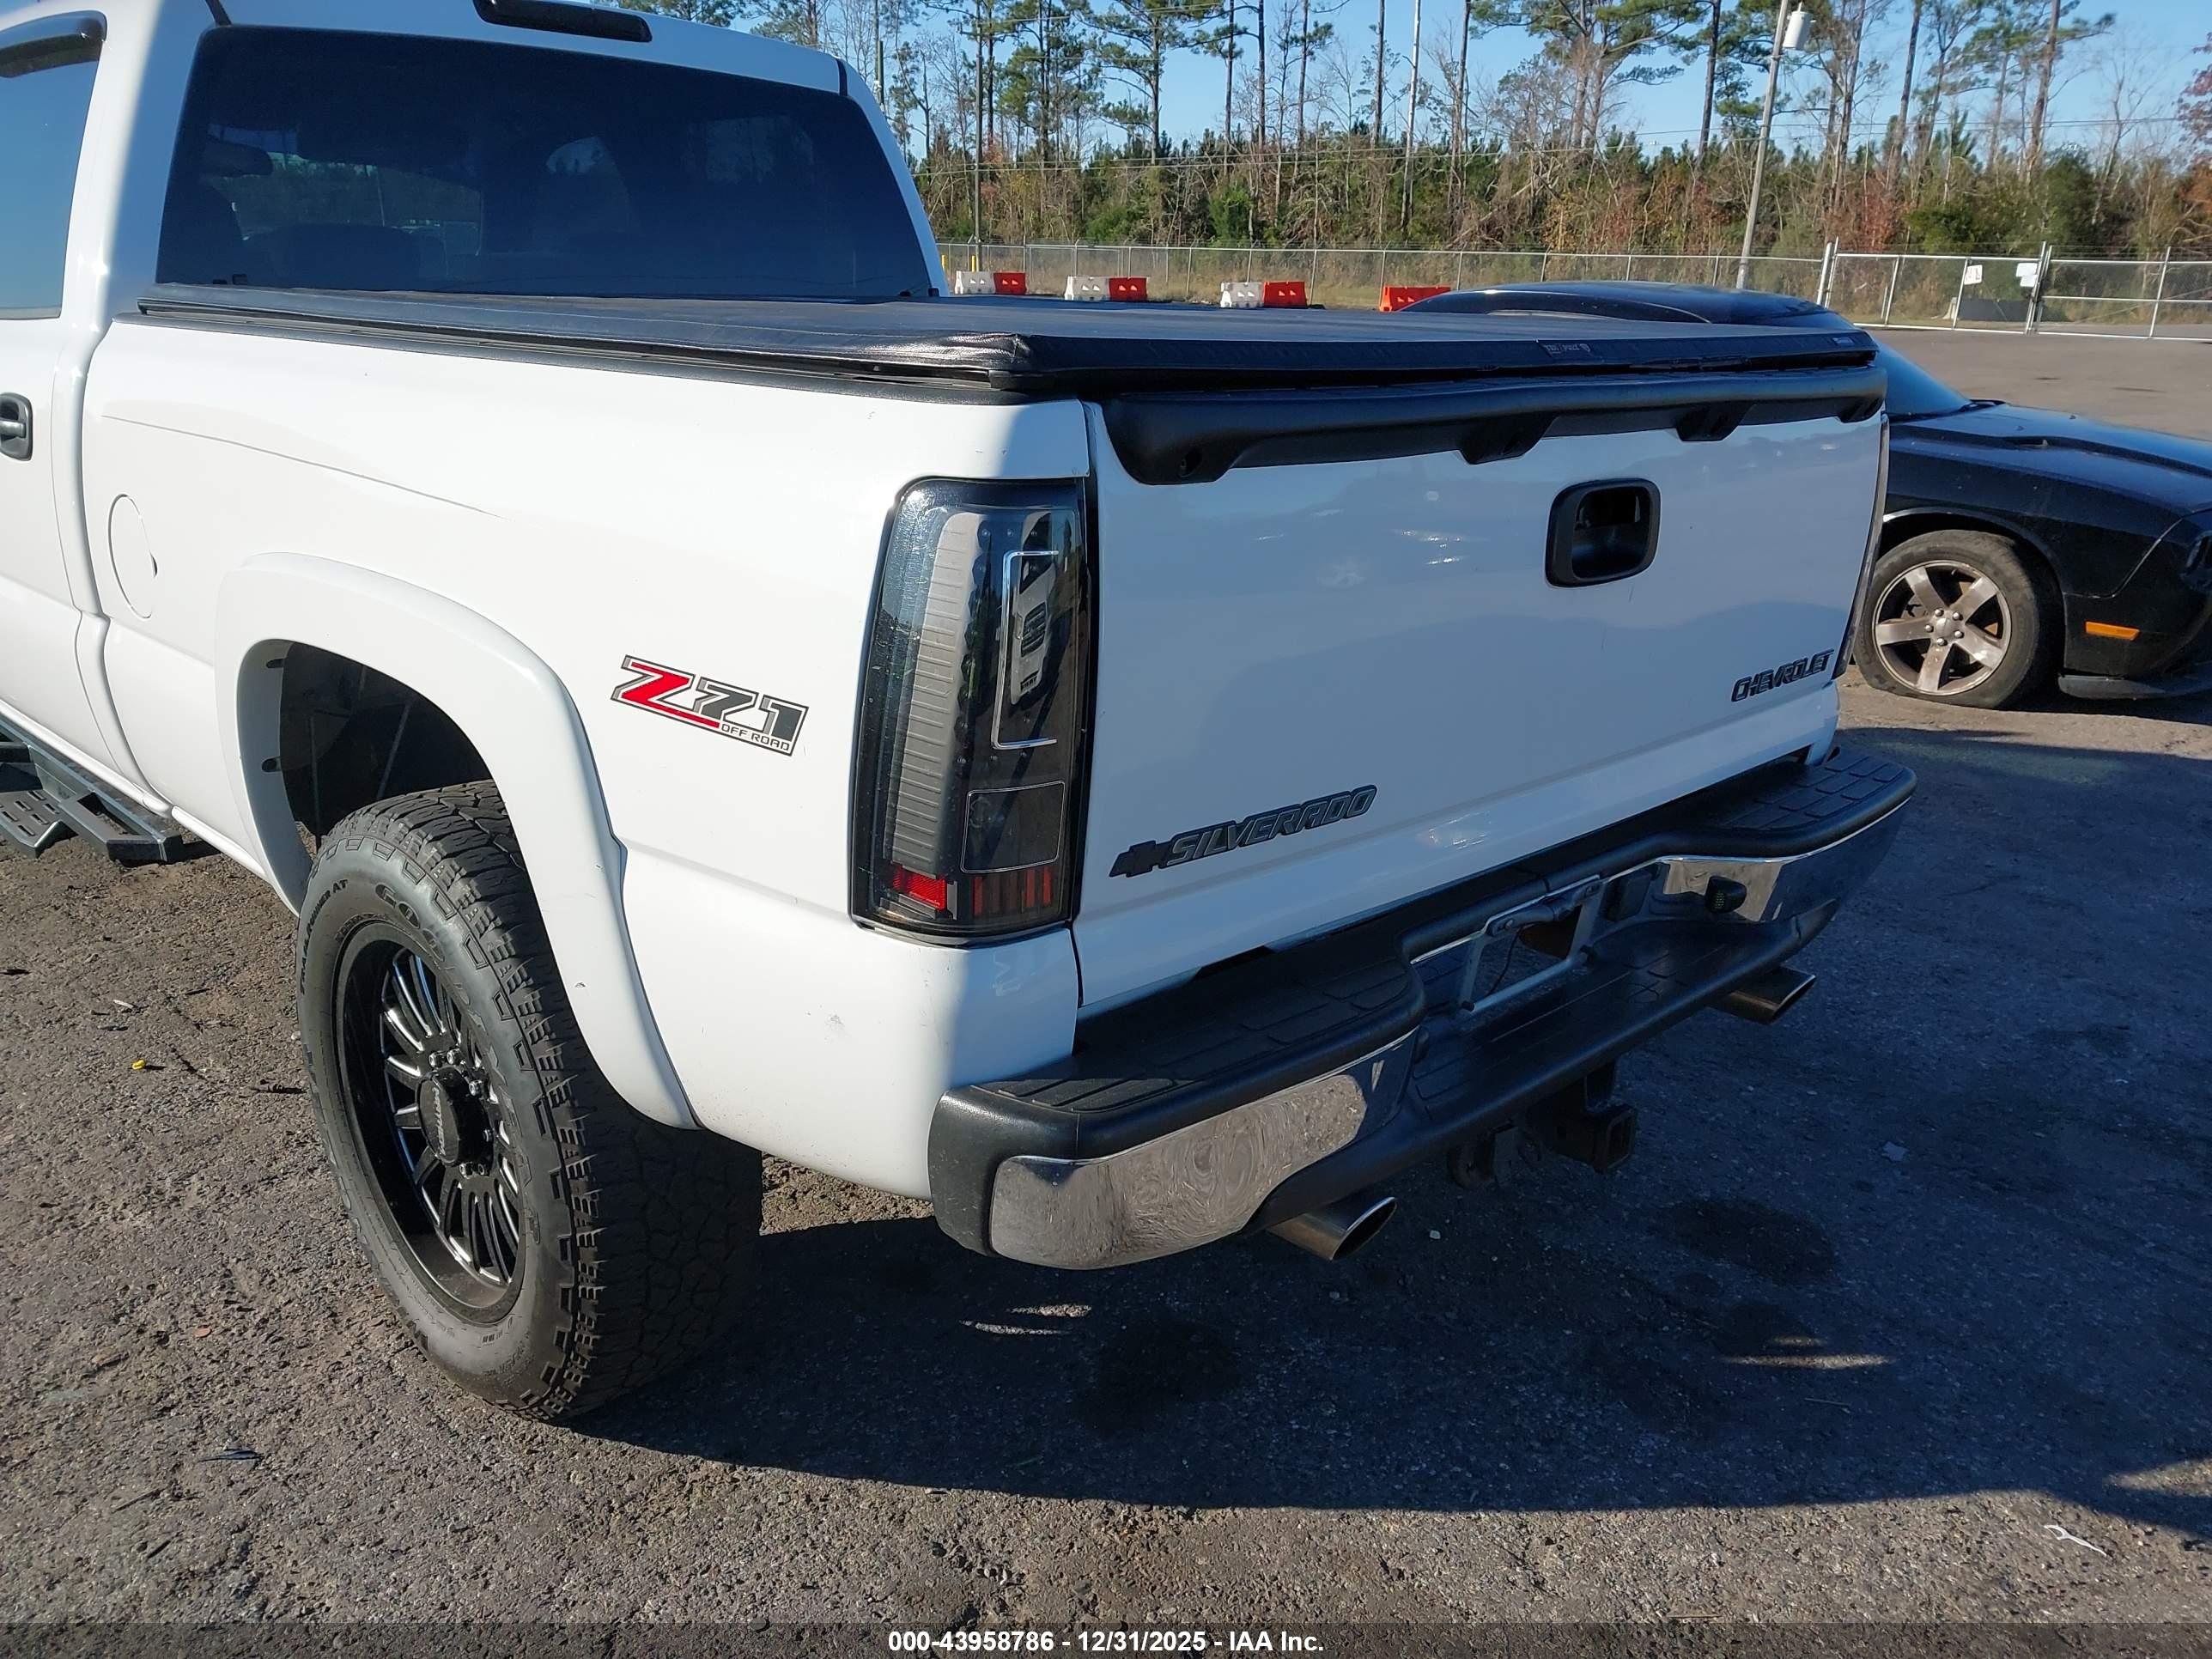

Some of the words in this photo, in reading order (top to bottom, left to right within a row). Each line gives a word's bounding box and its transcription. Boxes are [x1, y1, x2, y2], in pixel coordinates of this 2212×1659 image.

[611, 654, 810, 756] Z71
[1731, 647, 1834, 702] CHEVROLET
[721, 723, 749, 738] OFF
[751, 731, 790, 751] ROAD
[1160, 785, 1377, 868] SILVERADO
